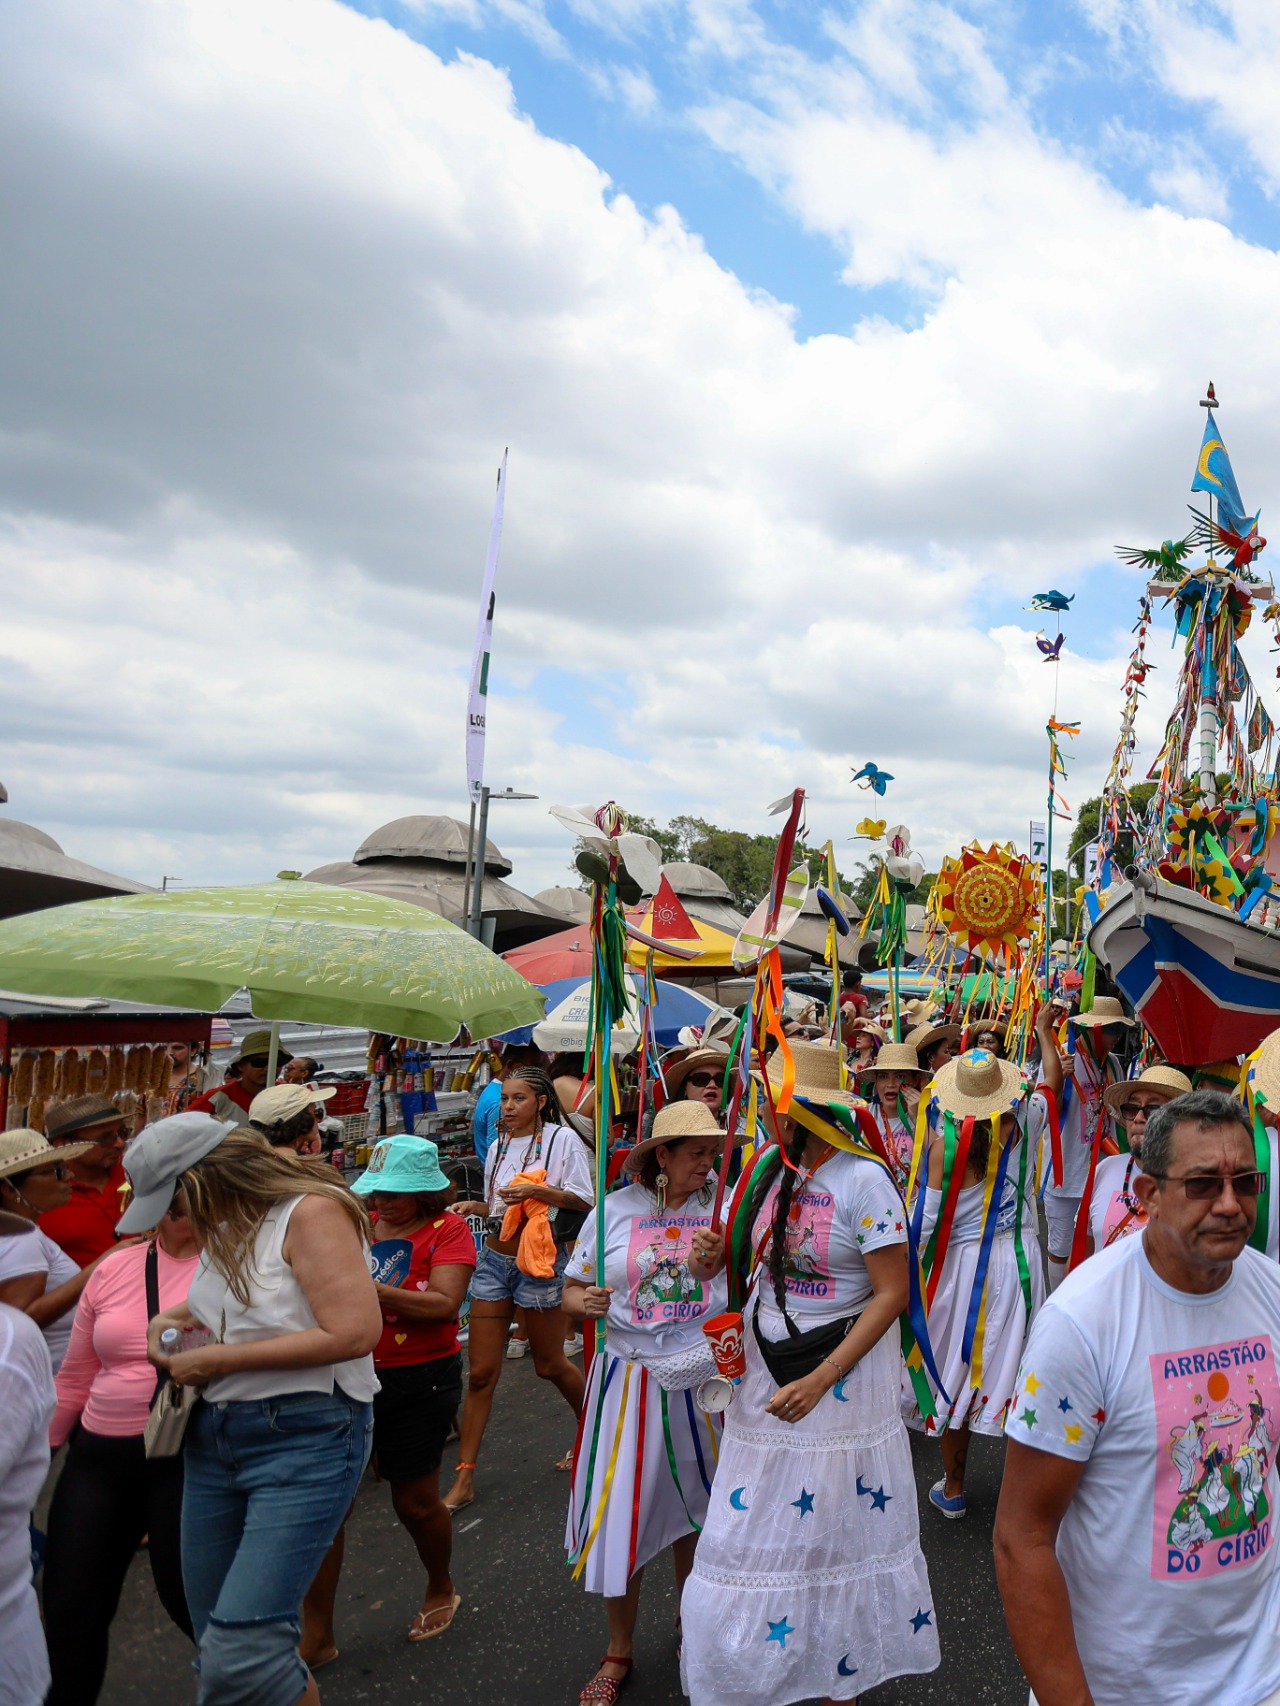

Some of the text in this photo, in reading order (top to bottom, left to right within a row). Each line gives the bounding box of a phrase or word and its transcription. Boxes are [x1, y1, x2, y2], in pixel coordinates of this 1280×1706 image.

[638, 1216, 711, 1229] ARRASTÃO
[636, 1300, 703, 1321] DO CÍRIO
[1163, 1341, 1266, 1379] ARRASTÃO
[1167, 1523, 1270, 1573] DO CÍRIO
